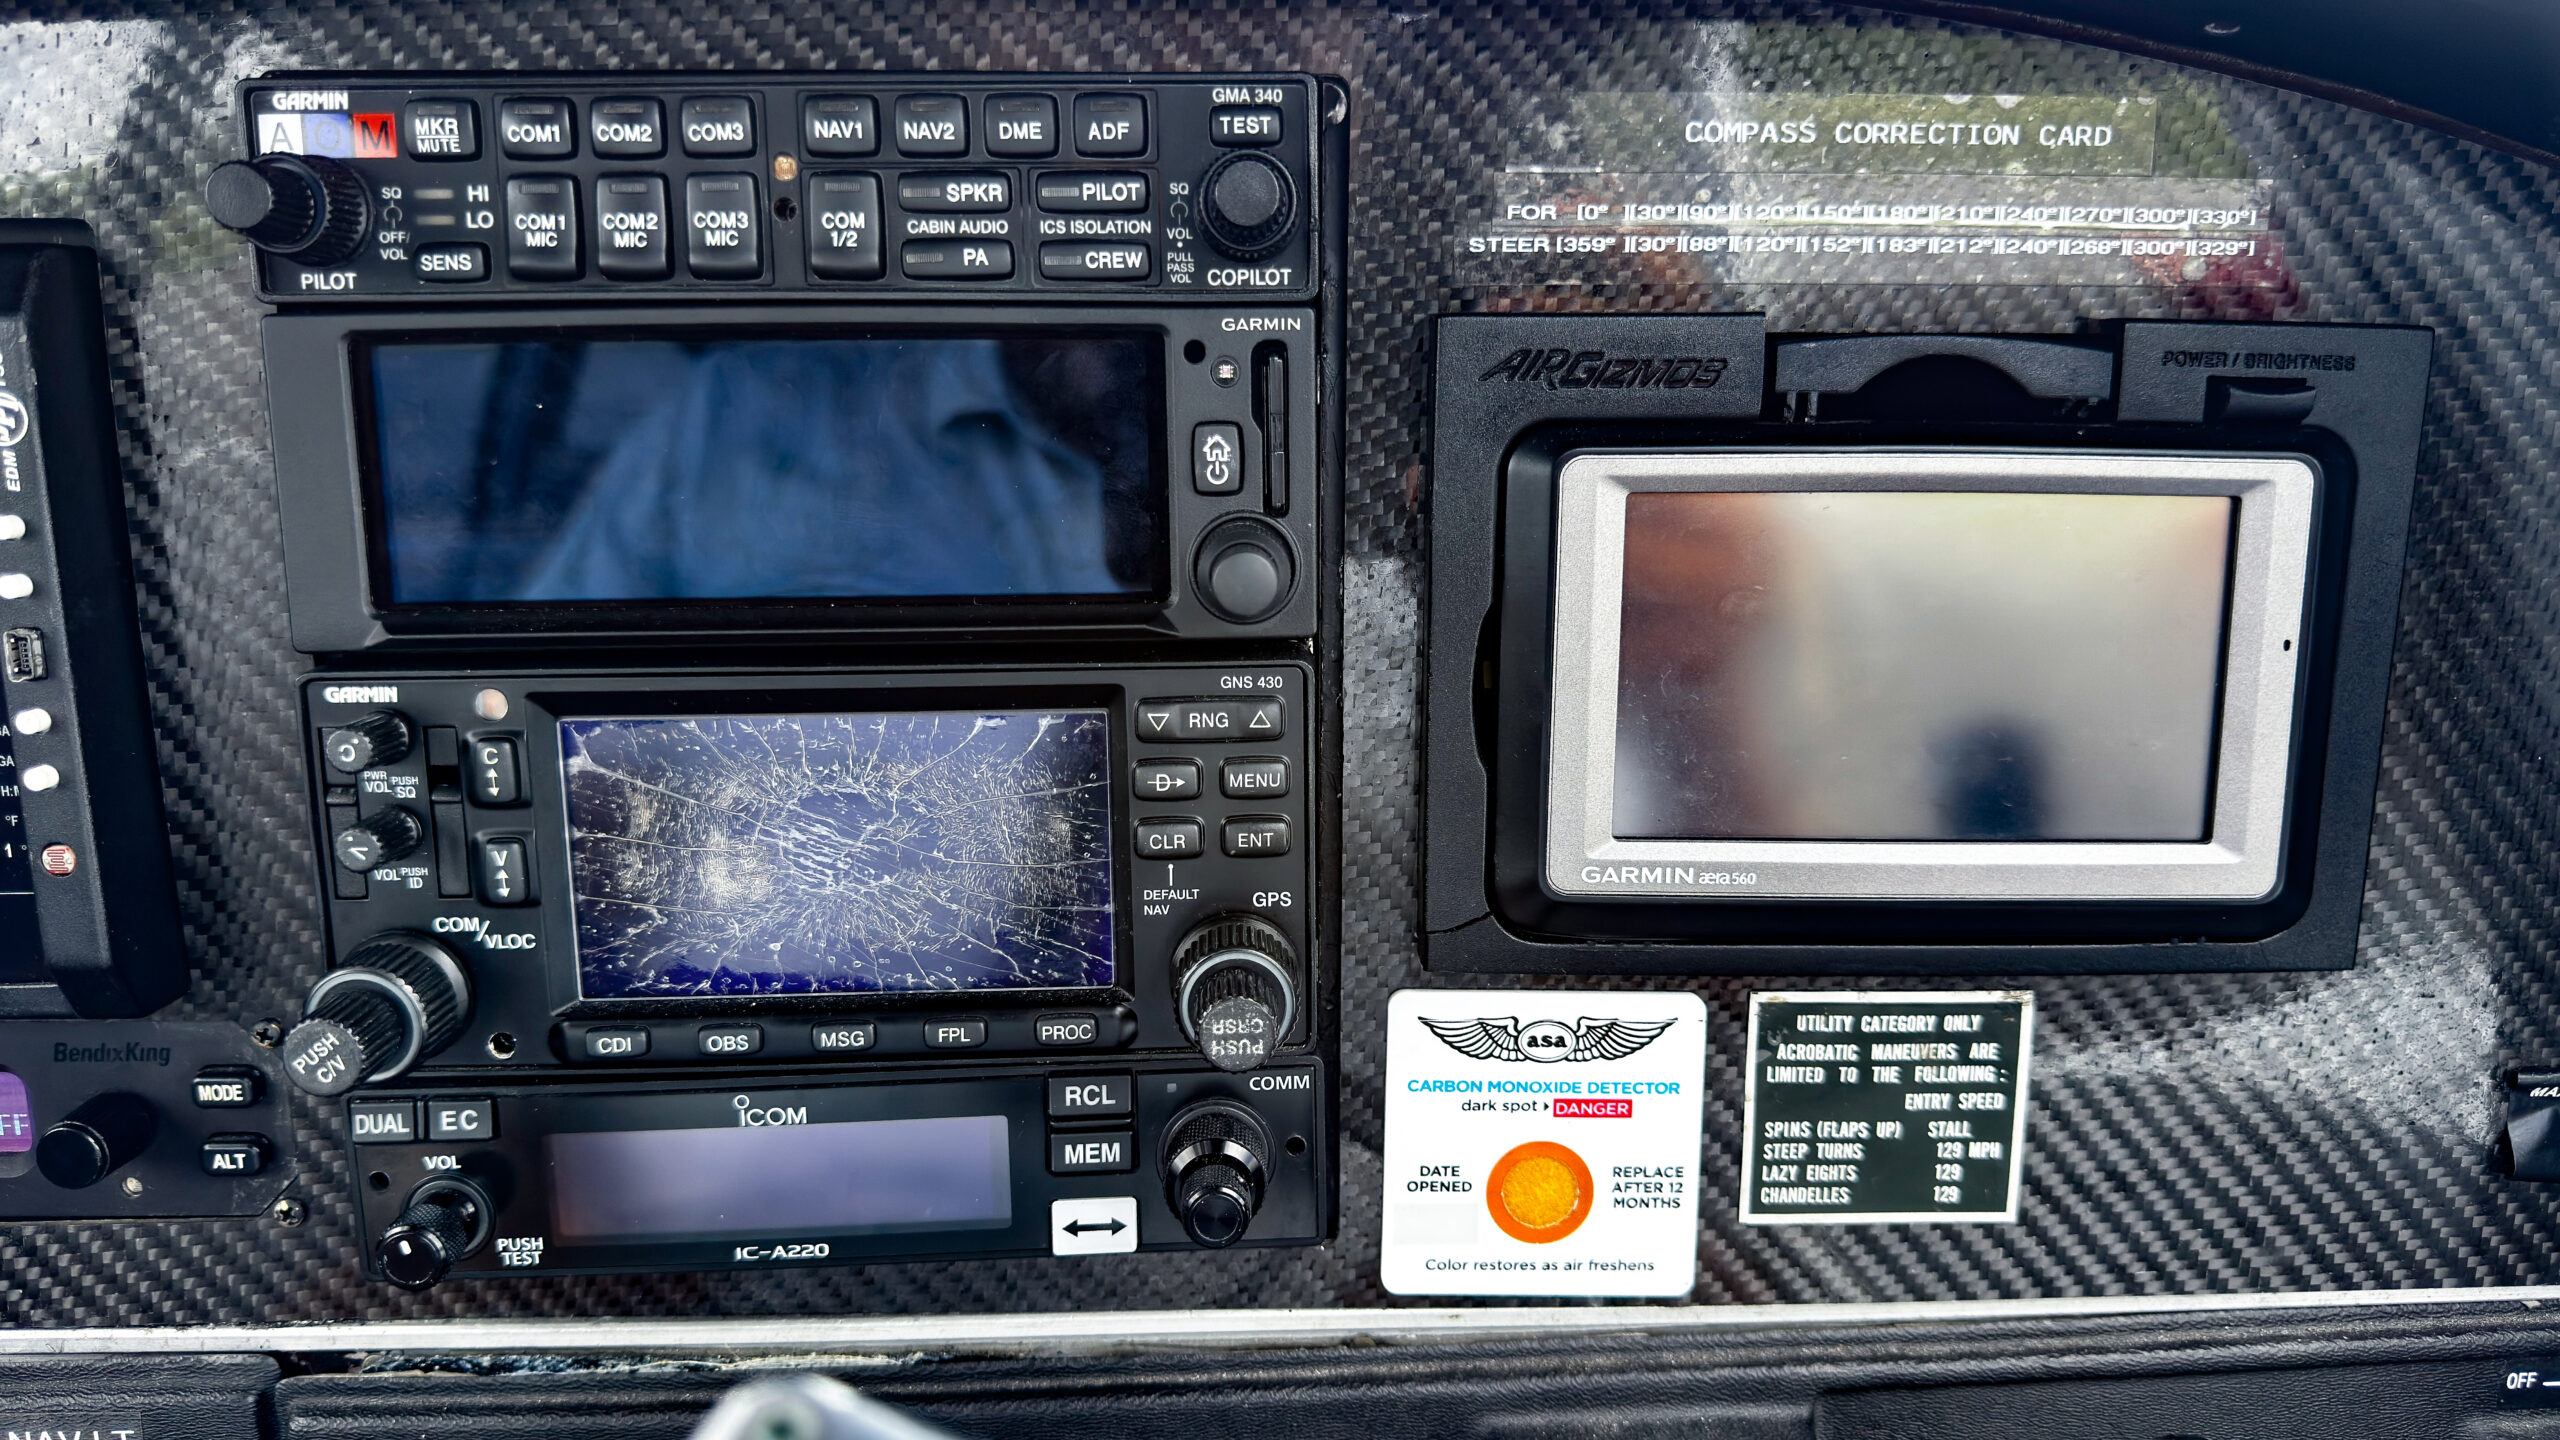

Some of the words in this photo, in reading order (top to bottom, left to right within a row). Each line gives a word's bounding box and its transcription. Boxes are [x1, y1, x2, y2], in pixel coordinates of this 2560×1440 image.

[272, 92, 348, 110] GARMIN
[1212, 88, 1246, 103] GMA
[1250, 88, 1283, 103] 340
[415, 118, 459, 136] MKR
[507, 125, 561, 143] COM1
[596, 124, 653, 143] COM2
[688, 123, 744, 142] COM3
[814, 122, 863, 139] NAV1
[904, 123, 955, 140] NAV2
[999, 123, 1042, 140] DME
[1088, 123, 1130, 141] ADF
[1220, 117, 1271, 135] TEST
[1684, 121, 1817, 144] COMPASS
[1835, 122, 2020, 146] CORRECTION
[2039, 125, 2112, 147] CARD
[271, 122, 293, 151] A
[361, 121, 390, 150] M
[416, 138, 461, 153] MUTE
[382, 187, 402, 200] SQ
[468, 186, 489, 202] HI
[946, 184, 1003, 202] SPKR
[1082, 183, 1140, 201] PILOT
[1169, 182, 1190, 197] SQ
[467, 212, 494, 229] LO
[694, 212, 748, 229] COM3
[1507, 204, 1557, 221] FOR
[515, 214, 566, 231] COM1
[603, 214, 658, 231] COM2
[822, 213, 865, 230] COM
[907, 220, 958, 234] CABIN
[960, 220, 1008, 235] AUDIO
[1040, 220, 1066, 234] ICS
[1070, 220, 1152, 234] ISOLATION
[527, 232, 557, 248] MIC
[615, 232, 647, 249] MIC
[706, 230, 738, 247] MIC
[831, 231, 858, 248] 1/2
[1166, 227, 1193, 241] VOL
[1469, 236, 1550, 253] STEER
[380, 248, 408, 261] VOL
[420, 254, 472, 271] SENS
[963, 249, 989, 266] PA
[1085, 252, 1142, 270] CREW
[1167, 252, 1194, 263] PULL
[1167, 262, 1195, 273] PASS
[301, 273, 357, 290] PILOT
[1170, 273, 1192, 284] VOL
[1207, 268, 1292, 287] COPILOT
[1221, 318, 1301, 332] GARMIN
[2162, 350, 2228, 368] POWER
[2243, 352, 2355, 371] BRIGHTNESS
[3, 449, 21, 492] EDM
[1220, 676, 1253, 689] GNS
[1257, 676, 1283, 689] 430
[324, 687, 398, 703] GARMIN
[1189, 713, 1229, 728] RNG
[483, 748, 498, 765] C
[364, 771, 387, 780] PWR
[392, 777, 419, 786] PUSH
[1229, 773, 1281, 788] MENU
[365, 781, 392, 795] VOL
[396, 786, 416, 799] SQ
[1149, 834, 1186, 850] CLR
[1238, 833, 1274, 848] ENT
[493, 851, 509, 867] V
[374, 869, 401, 882] VOL
[401, 867, 429, 877] PUSH
[1581, 866, 1694, 884] GARMIN
[409, 877, 423, 889] ID
[1143, 889, 1200, 901] DEFAULT
[1252, 892, 1292, 908] GPS
[1143, 904, 1171, 916] NAV
[1042, 1023, 1092, 1041] PROC
[1797, 1015, 1853, 1032] UTILITY
[1861, 1015, 1937, 1032] CATEGORY
[1943, 1015, 1982, 1032] ONLY
[707, 1035, 749, 1051] OBS
[820, 1030, 865, 1048] MSG
[938, 1028, 971, 1043] FPL
[1526, 1033, 1567, 1048] asa
[293, 1033, 340, 1075] PUSH
[598, 1037, 632, 1054] CDI
[1211, 1039, 1263, 1056] PUSH
[1776, 1044, 1860, 1061] ACROBATIC
[1871, 1043, 1958, 1061] MANEUVERS
[1969, 1043, 2001, 1060] ARE
[317, 1055, 345, 1084] C/V
[1766, 1066, 1826, 1083] LIMITED
[1839, 1066, 1859, 1083] TO
[1872, 1066, 1902, 1083] THE
[1250, 1075, 1310, 1091] COMM
[1407, 1079, 1483, 1093] CARBON
[1487, 1080, 1582, 1094] MONOXIDE
[1587, 1082, 1680, 1095] DETECTOR
[2530, 1086, 2560, 1097] MA
[199, 1085, 243, 1101] MODE
[1065, 1085, 1116, 1106] RCL
[1905, 1093, 1952, 1110] ENTRY
[1958, 1093, 2007, 1110] SPEED
[1461, 1099, 1496, 1111] dark
[1502, 1100, 1537, 1113] spot
[1555, 1102, 1629, 1115] DANGER
[355, 1112, 410, 1134] DUAL
[1764, 1121, 1812, 1139] SPINS
[1817, 1121, 1870, 1139] (FLAPS
[1876, 1121, 1904, 1139] UP)
[1928, 1121, 1973, 1138] STALL
[1065, 1142, 1121, 1164] MEM
[1763, 1143, 1809, 1160] STEEP
[1816, 1143, 1865, 1160] TURNS
[1937, 1142, 1964, 1159] 129
[1968, 1142, 2002, 1159] MPH
[213, 1153, 246, 1170] ALT
[423, 1156, 462, 1170] VOL
[1420, 1165, 1460, 1177] DATE
[1612, 1166, 1684, 1178] REPLACE
[1762, 1165, 1798, 1182] LAZY
[1806, 1165, 1859, 1182] EIGHTS
[1935, 1164, 1963, 1181] 129
[1407, 1181, 1472, 1193] OPENED
[1612, 1182, 1666, 1193] AFTER
[1669, 1182, 1683, 1193] 12
[1760, 1186, 1851, 1204] CHANDELLES
[1933, 1186, 1960, 1203] 129
[1613, 1197, 1681, 1209] MONTHS
[496, 1237, 544, 1252] PUSH
[734, 1244, 830, 1261] IC-A220
[501, 1250, 542, 1266] TEST
[1425, 1258, 1469, 1271] Color
[1473, 1260, 1536, 1271] restores
[1541, 1261, 1558, 1271] as
[1563, 1259, 1582, 1271] air
[1588, 1259, 1654, 1271] freshens
[2506, 1372, 2538, 1389] OFF
